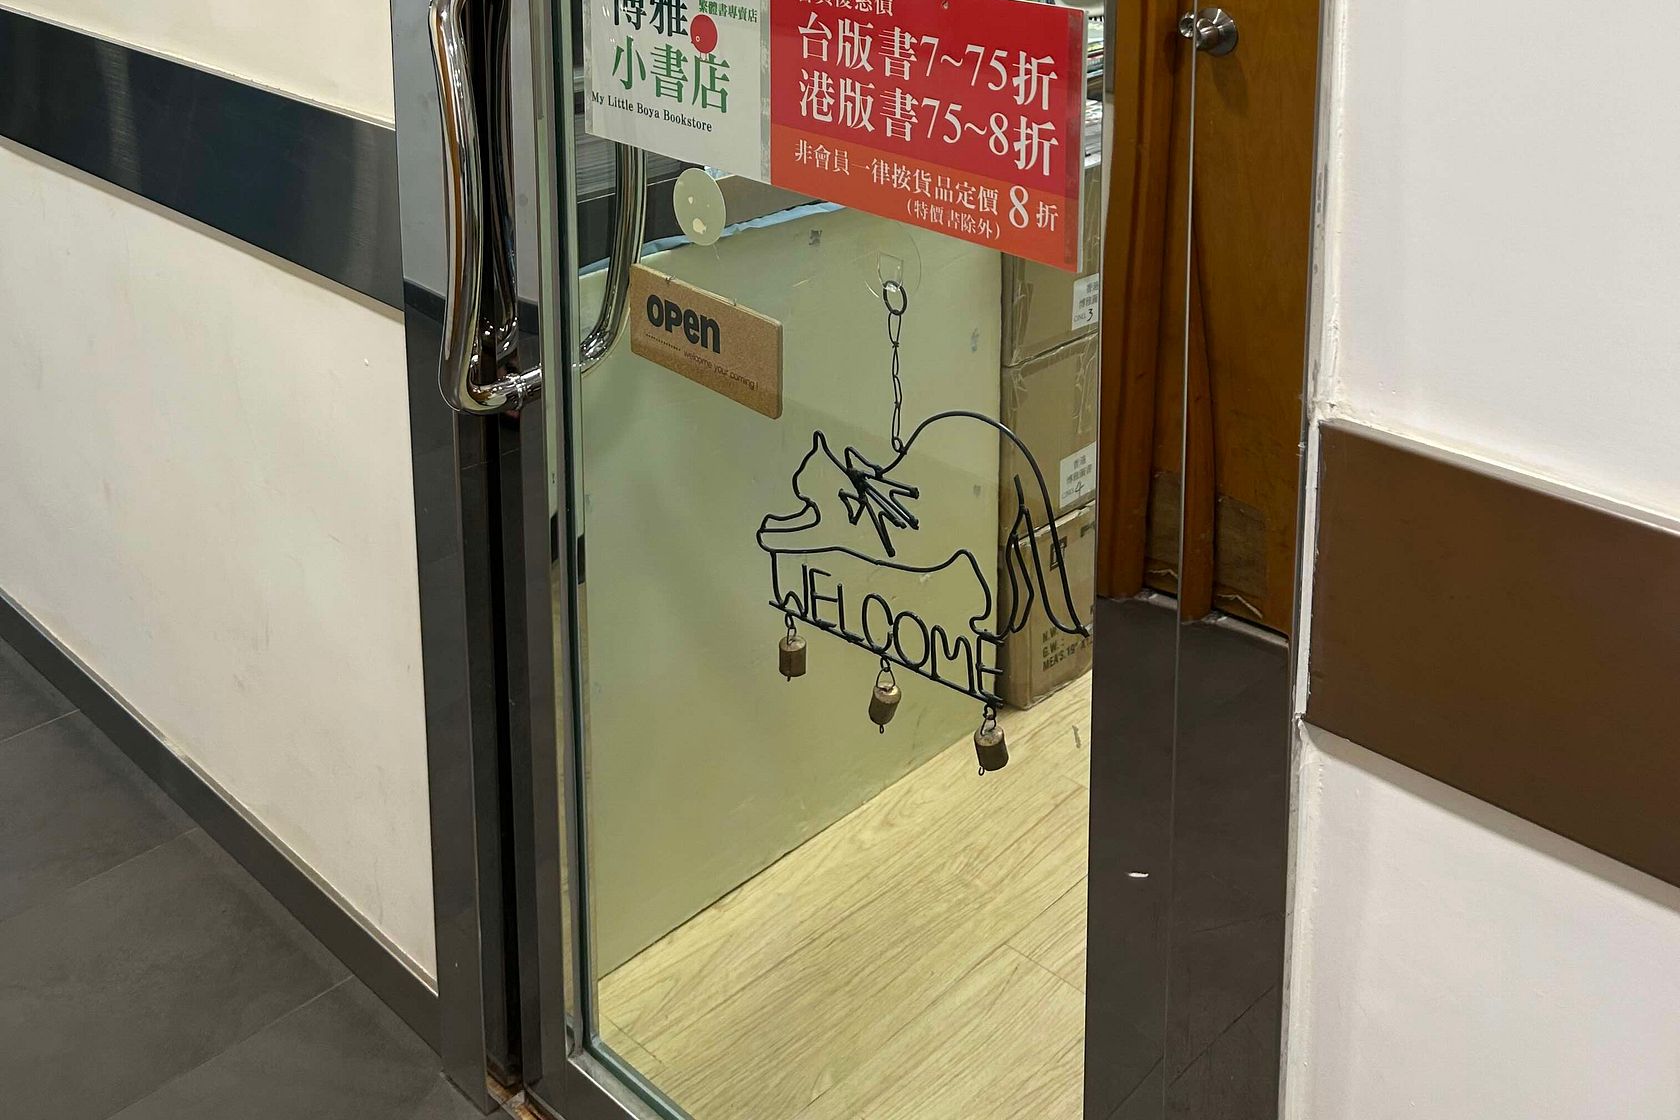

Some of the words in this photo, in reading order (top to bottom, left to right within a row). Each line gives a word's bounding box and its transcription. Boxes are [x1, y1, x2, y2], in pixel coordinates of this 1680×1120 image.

[699, 0, 757, 23] 繁體書專賣店
[612, 36, 730, 113] 小書店
[592, 91, 605, 105] My
[608, 95, 634, 112] Little
[637, 102, 660, 120] Boya
[664, 109, 712, 133] Bookstore
[684, 350, 713, 369] welcome
[713, 363, 729, 376] your
[769, 557, 1004, 707] WELCOME
